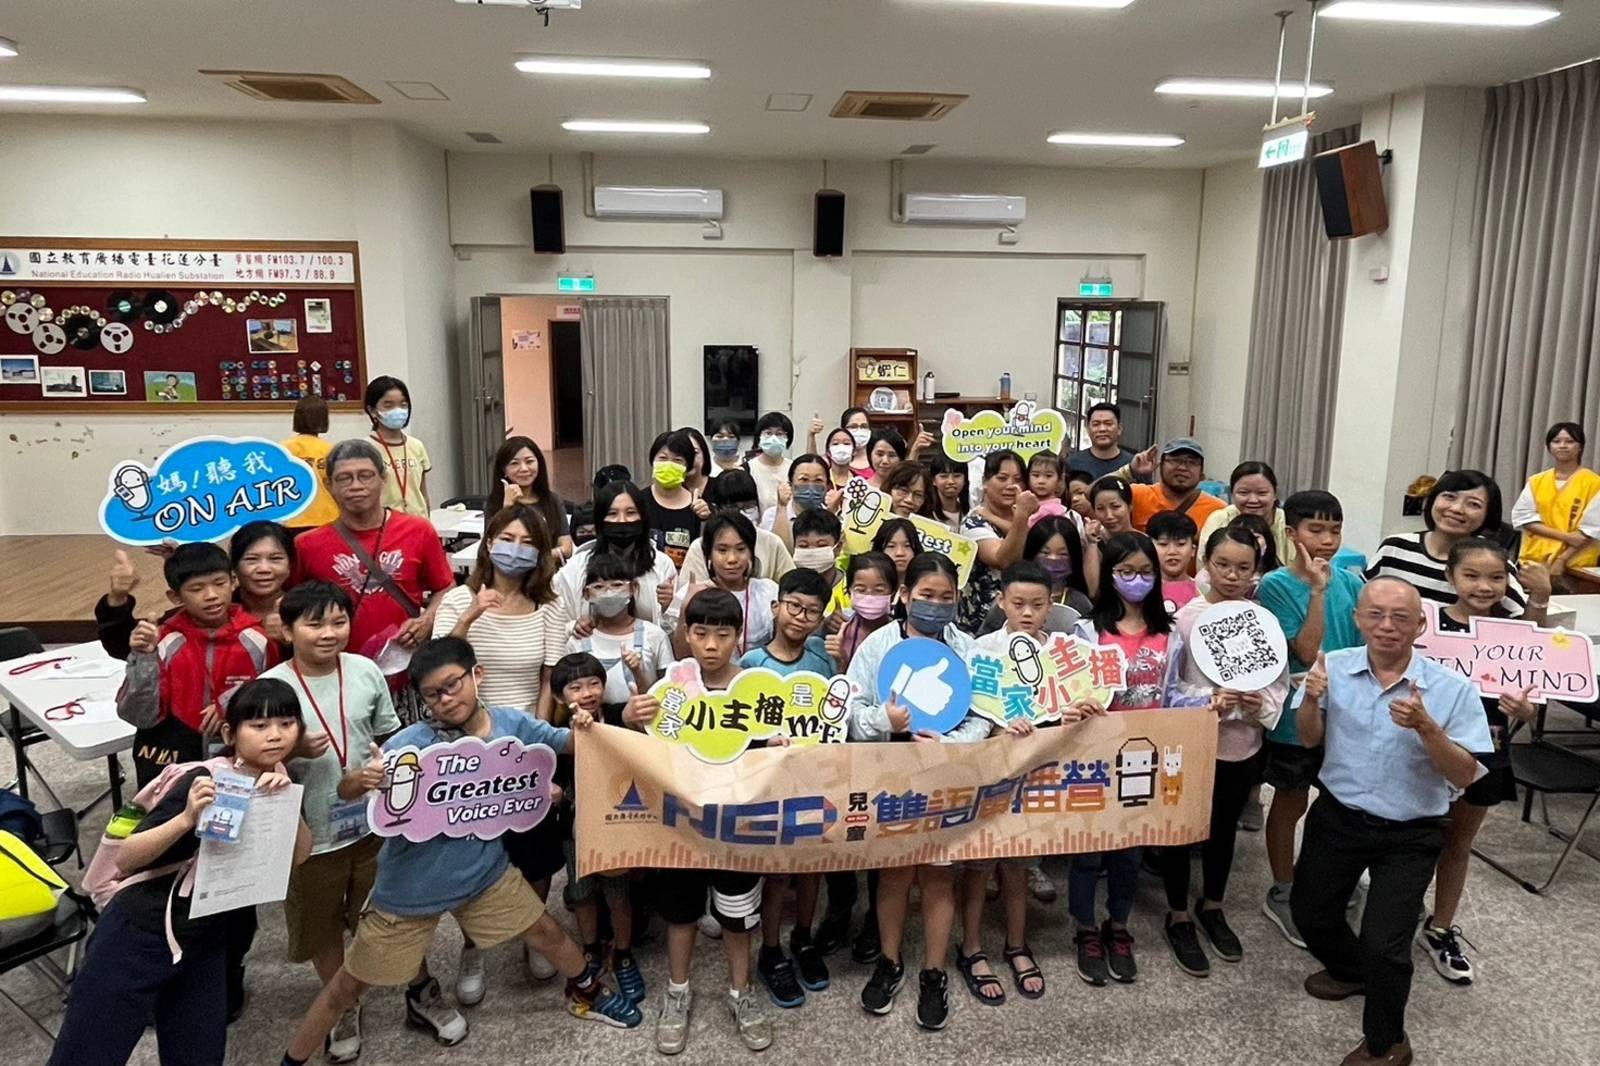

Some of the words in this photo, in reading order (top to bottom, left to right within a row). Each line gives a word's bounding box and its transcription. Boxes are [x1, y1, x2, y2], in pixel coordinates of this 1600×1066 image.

[267, 255, 305, 265] FM103.7
[317, 256, 344, 265] 100.3
[32, 270, 68, 279] National
[71, 270, 114, 279] Education
[116, 270, 141, 279] Radio
[144, 271, 177, 280] Hualien
[179, 271, 225, 280] Substation
[268, 269, 301, 279] FM97.3
[952, 428, 984, 438] Open
[987, 425, 1018, 438] your
[1019, 422, 1052, 434] mind
[957, 442, 982, 453] into
[985, 441, 1013, 454] your
[1016, 439, 1051, 449] heart
[153, 492, 216, 533] ON
[225, 475, 301, 518] AIR
[1473, 644, 1544, 662] YOUR
[1500, 666, 1587, 692] MIND
[790, 682, 814, 708] 是
[658, 686, 687, 739] 當家
[685, 691, 786, 733] 小主播
[436, 754, 481, 777] The
[427, 770, 540, 804] Greatest
[447, 803, 499, 825] Voice
[502, 795, 543, 815] Ever
